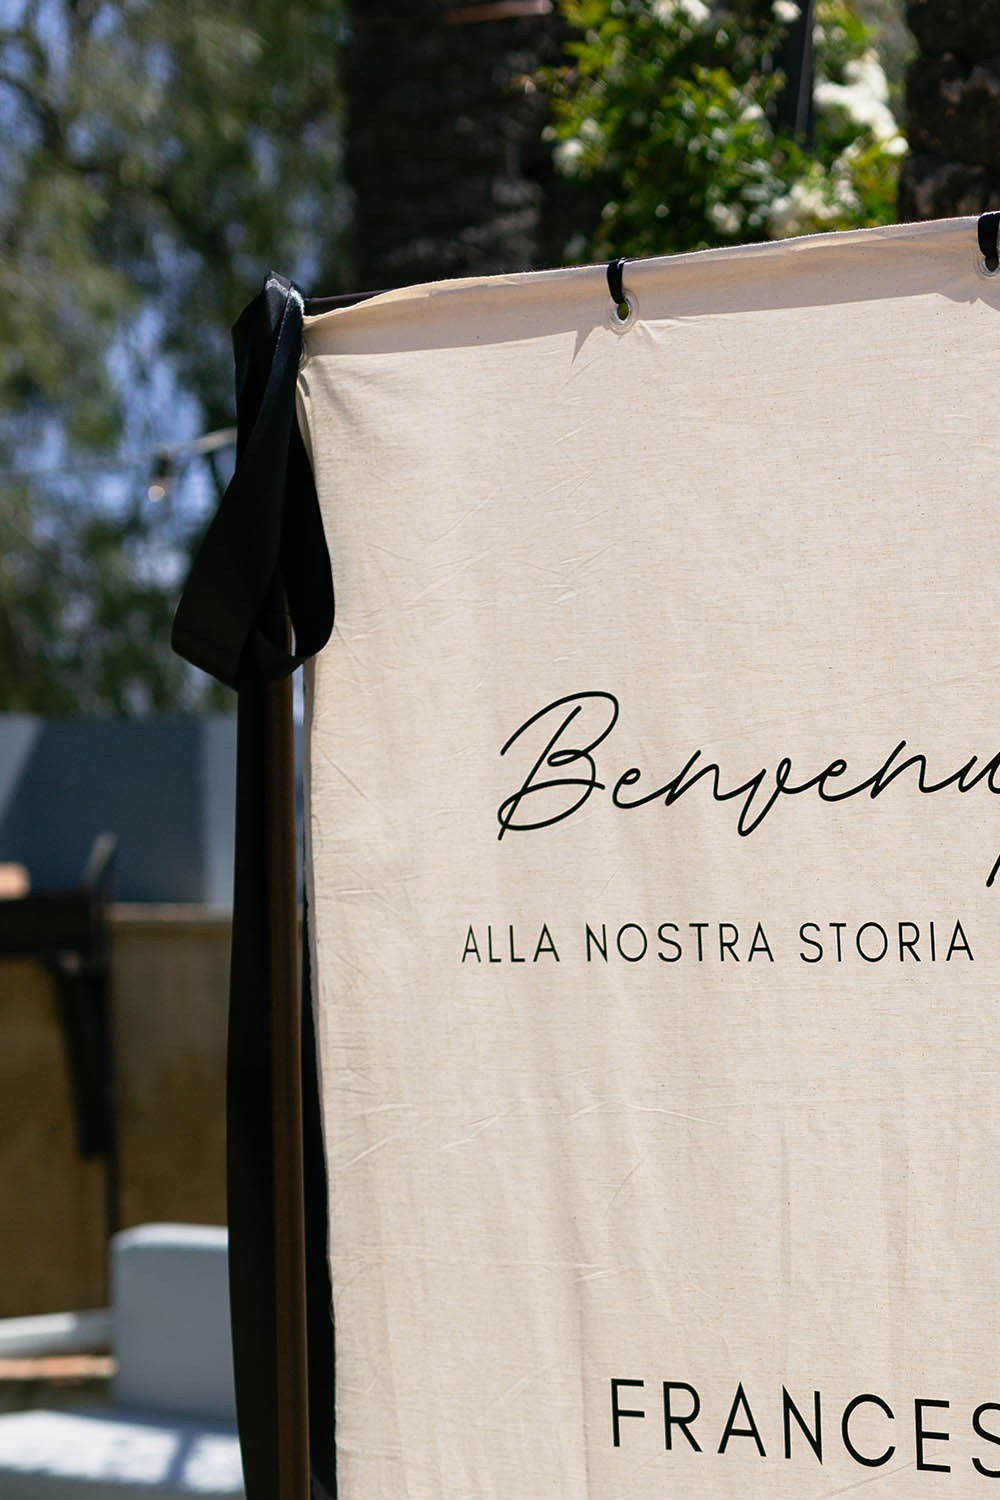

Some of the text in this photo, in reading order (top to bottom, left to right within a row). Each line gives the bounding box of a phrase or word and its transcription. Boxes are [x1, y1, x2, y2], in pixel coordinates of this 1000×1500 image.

[461, 922, 561, 963] ALLA
[585, 921, 775, 963] NOSTRA
[798, 921, 975, 964] STORIA
